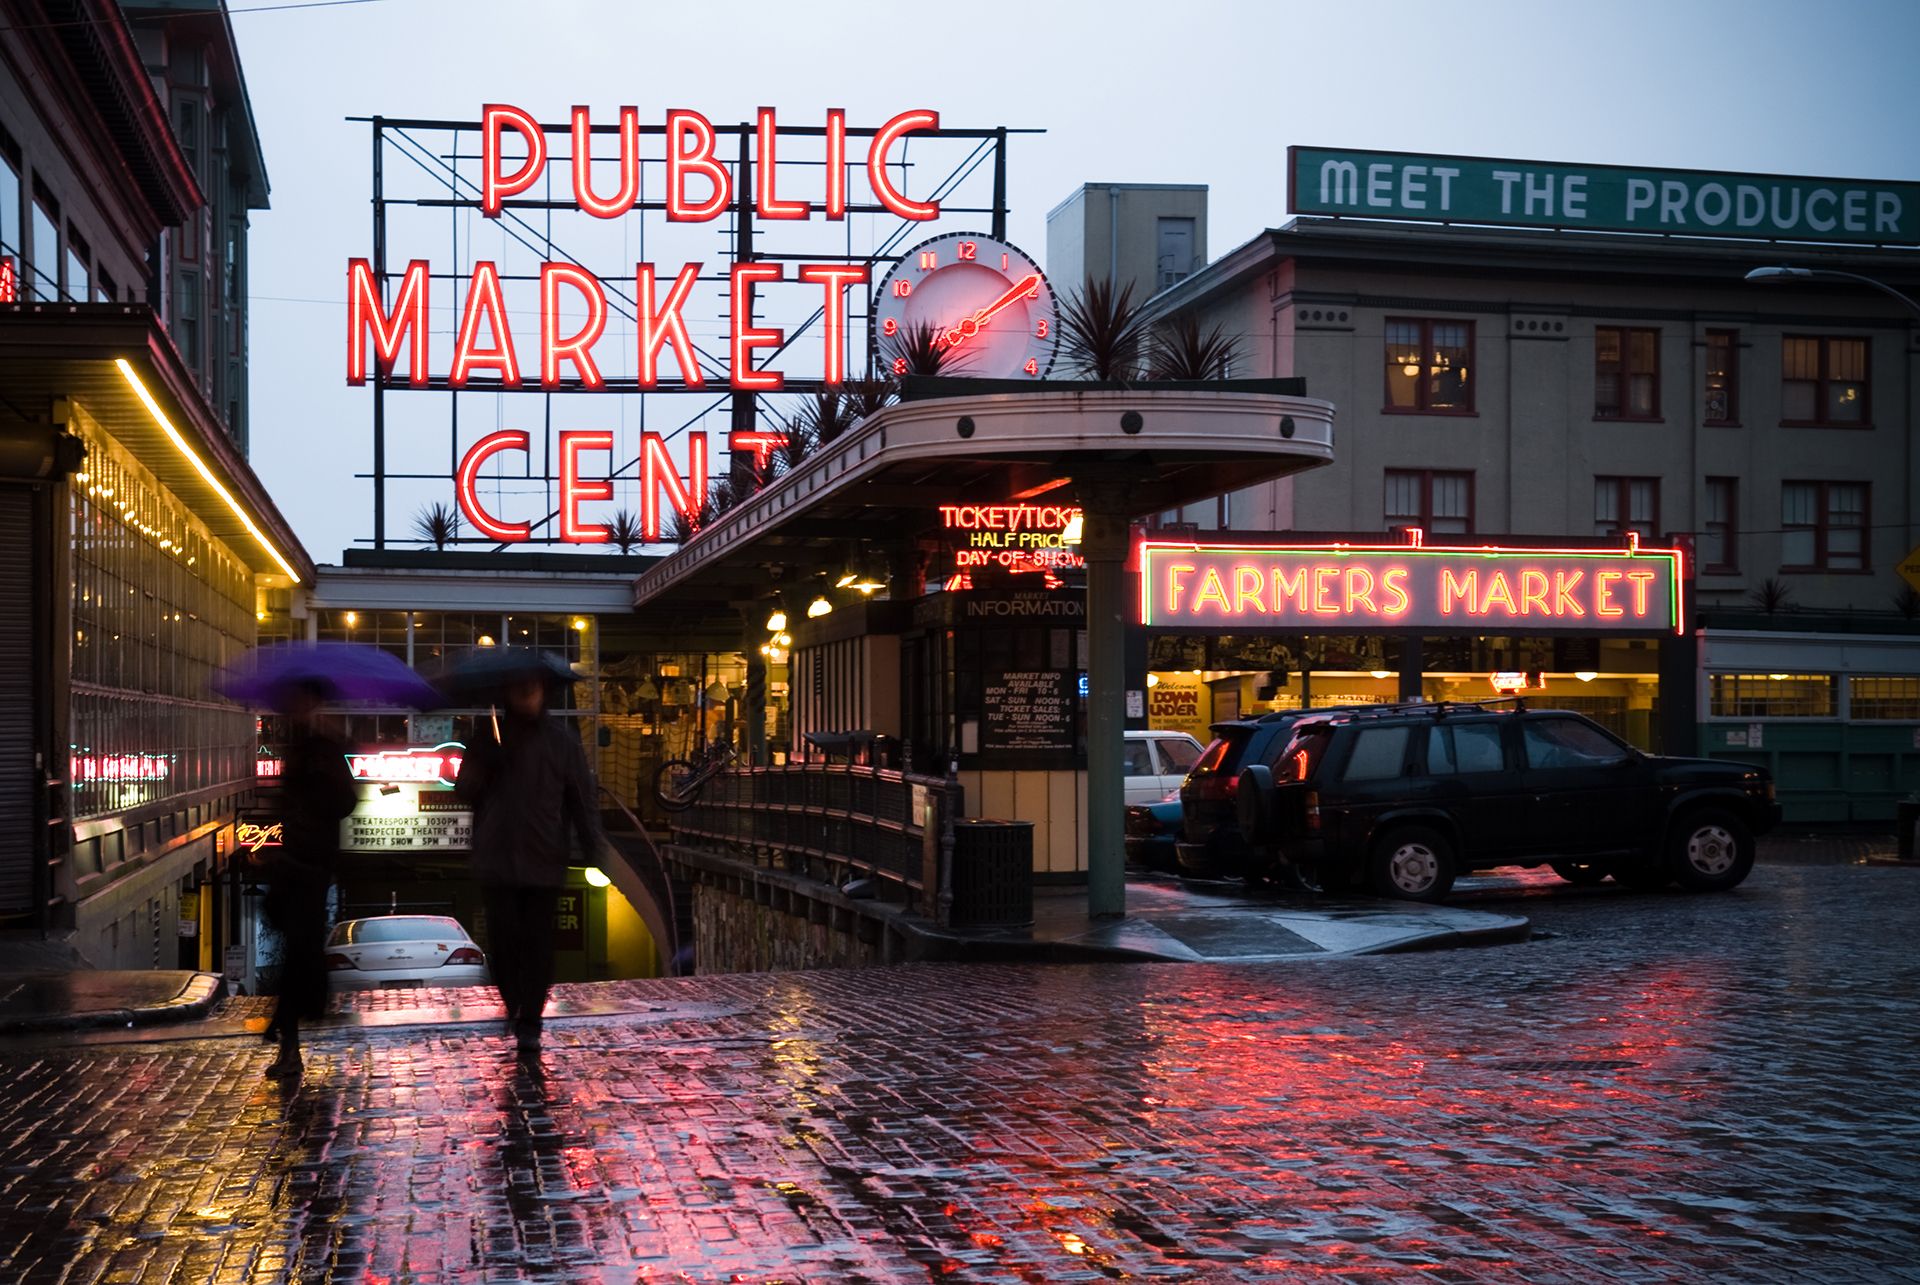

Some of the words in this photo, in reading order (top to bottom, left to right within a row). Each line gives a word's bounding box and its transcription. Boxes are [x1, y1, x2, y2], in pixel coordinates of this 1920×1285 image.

[482, 103, 940, 222] PUBLIC
[1320, 159, 1460, 212] MEET
[1492, 170, 1588, 219] THE
[1625, 177, 1902, 233] PRODUCER
[957, 241, 977, 260] 12
[921, 252, 936, 270] 11
[893, 280, 912, 297] 10
[347, 258, 868, 391] MARKET
[883, 318, 898, 337] 9
[1036, 319, 1048, 339] 3
[1024, 358, 1038, 375] 4
[456, 429, 790, 544] CENT
[970, 532, 1017, 548] HALF
[1019, 532, 1070, 549] PRICE
[956, 550, 1084, 569] DAY-OF-SHOW
[1166, 563, 1410, 616] FARMERS
[1440, 568, 1656, 618] MARKET
[967, 600, 1085, 616] INFORMATION
[1003, 672, 1040, 681] MARKET
[1041, 672, 1061, 681] INFO
[1008, 680, 1055, 689] AVAILABLE
[985, 687, 1007, 695] MON
[1013, 687, 1029, 695] FRI
[1153, 691, 1199, 704] DOWN
[985, 696, 1001, 704] SAT
[1007, 696, 1027, 704] SUN
[1034, 697, 1061, 705] NOON
[1000, 705, 1031, 713] TICKET
[987, 713, 1004, 721] TUE
[1011, 713, 1031, 721] SUN
[1034, 714, 1061, 722] NOON
[1150, 704, 1198, 716] UNDER
[352, 817, 419, 826] THEATRESPORTS
[427, 817, 459, 826] 1030PM
[353, 827, 406, 836] UNEXPECTED
[412, 827, 448, 836] THEATRE
[454, 828, 471, 836] 830
[353, 837, 386, 846] PUPPET
[390, 837, 413, 846] SHOW
[422, 837, 439, 846] 5PM
[448, 837, 472, 846] IMPR
